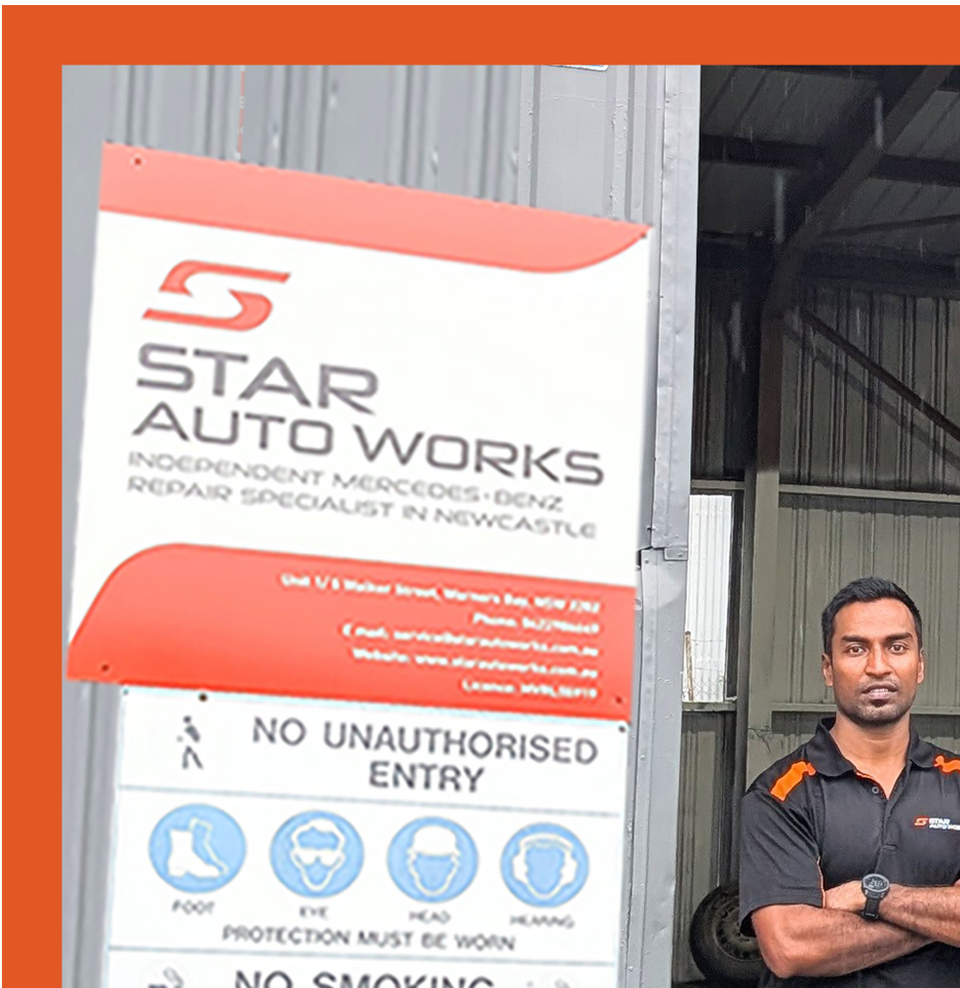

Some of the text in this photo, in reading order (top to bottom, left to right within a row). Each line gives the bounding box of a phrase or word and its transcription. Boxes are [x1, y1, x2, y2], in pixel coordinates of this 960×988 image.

[137, 342, 379, 416] STAR
[132, 401, 605, 487] AUTO WORKS
[128, 450, 325, 486] INDEPENDENT
[127, 475, 597, 539] REPAIR SPECIALIST IN NEWCASTLE
[251, 717, 599, 766] NO UNAUTHORISED
[368, 761, 485, 793] ENTRY
[171, 899, 216, 916] FOOT
[299, 904, 329, 919] EYE
[408, 909, 452, 925] HEAD
[508, 914, 576, 930] HEARING
[221, 923, 516, 952] PROTECTION MUST BE WORN
